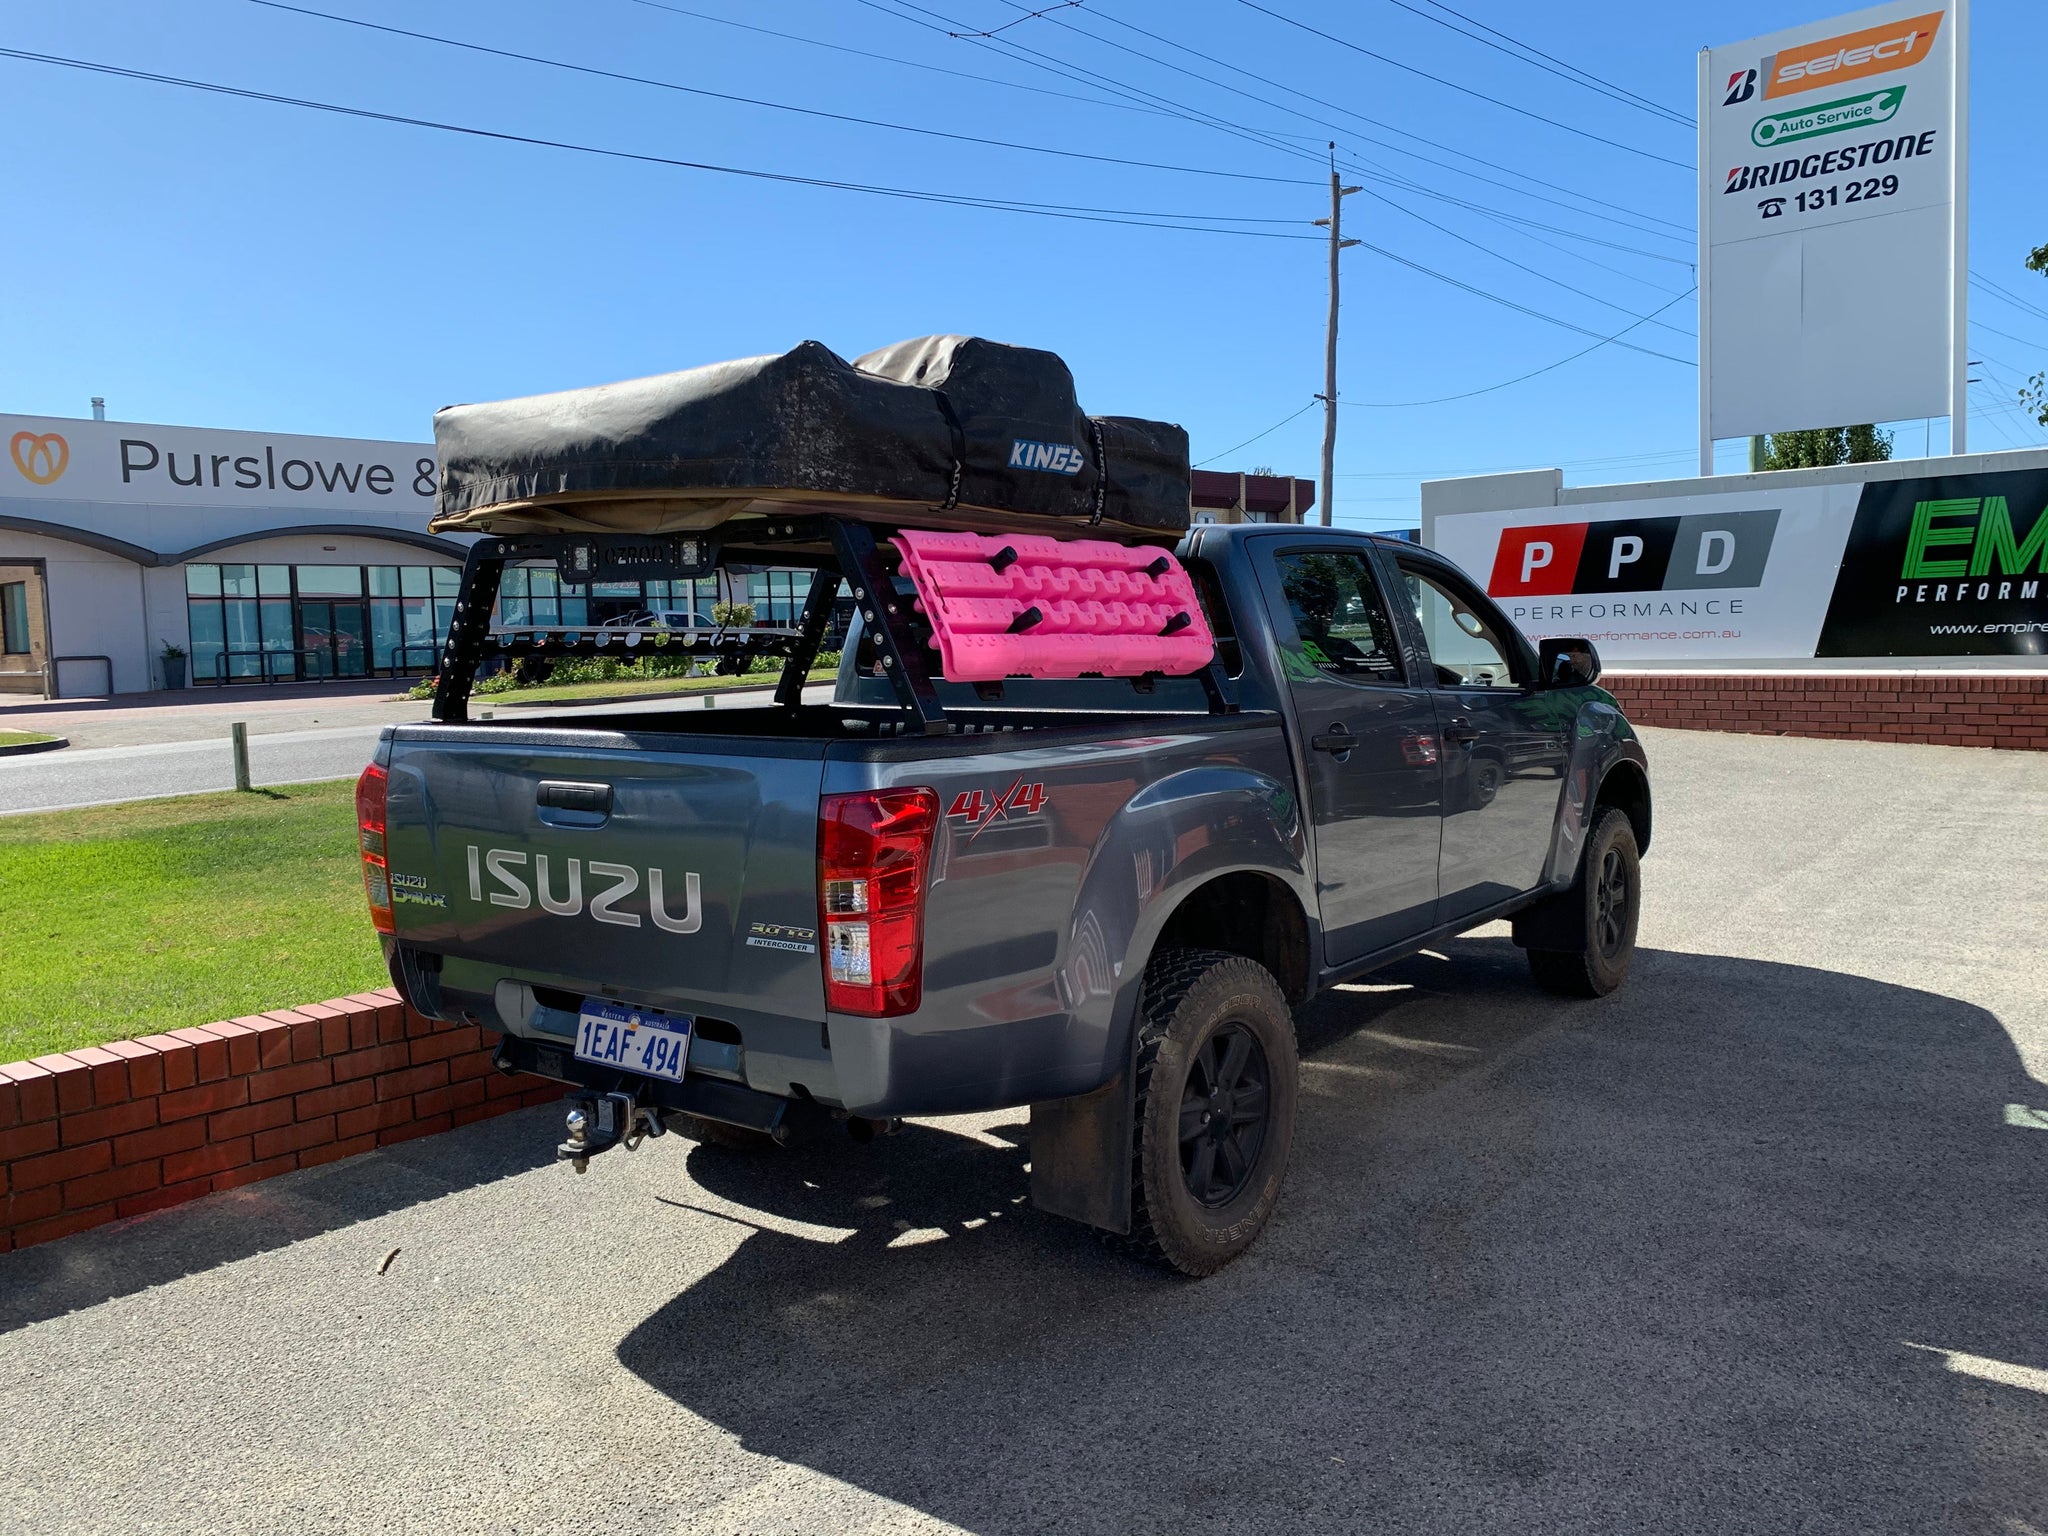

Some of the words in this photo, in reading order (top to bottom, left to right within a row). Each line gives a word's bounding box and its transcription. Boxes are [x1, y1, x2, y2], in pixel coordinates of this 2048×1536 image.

[1780, 119, 1813, 134] Auto
[1817, 105, 1873, 126] Service
[1724, 130, 1936, 194] BRIDGESTONE
[1795, 186, 1838, 212] 131
[1845, 175, 1899, 203] 229
[120, 438, 394, 495] Purslowe
[413, 457, 436, 497] &
[1010, 442, 1085, 473] KINGS
[947, 459, 962, 509] ADVE
[1901, 495, 2048, 580] EM
[1895, 580, 2048, 603] PERFORM
[1514, 599, 1744, 620] PERFORMANCE
[1930, 620, 2048, 635] www.empire
[390, 873, 427, 889] ISUZU
[467, 844, 702, 935] ISUZU
[753, 939, 808, 951] INTERCOOLER
